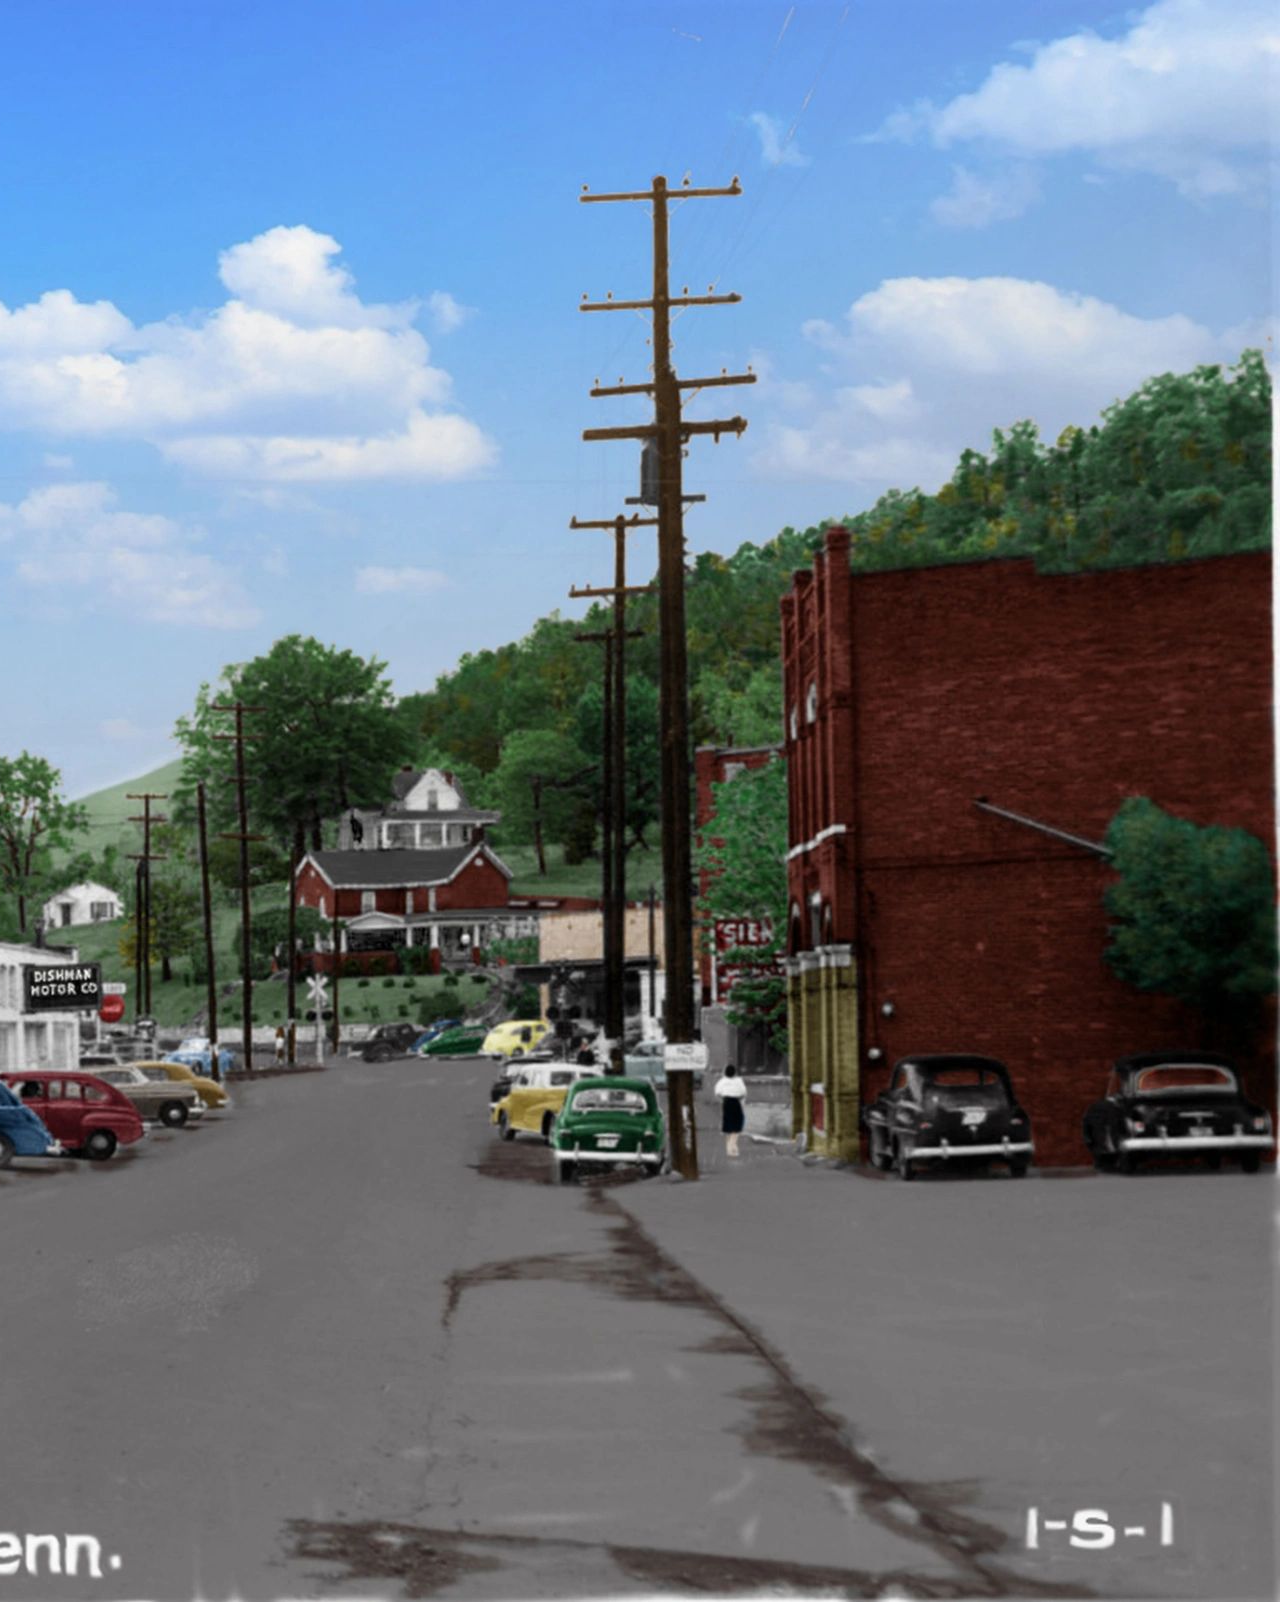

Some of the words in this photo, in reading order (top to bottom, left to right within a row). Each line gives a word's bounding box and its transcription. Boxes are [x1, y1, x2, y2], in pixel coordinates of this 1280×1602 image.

[34, 968, 93, 983] DISHMAN
[30, 983, 77, 996] MOTOR
[80, 982, 99, 994] CO
